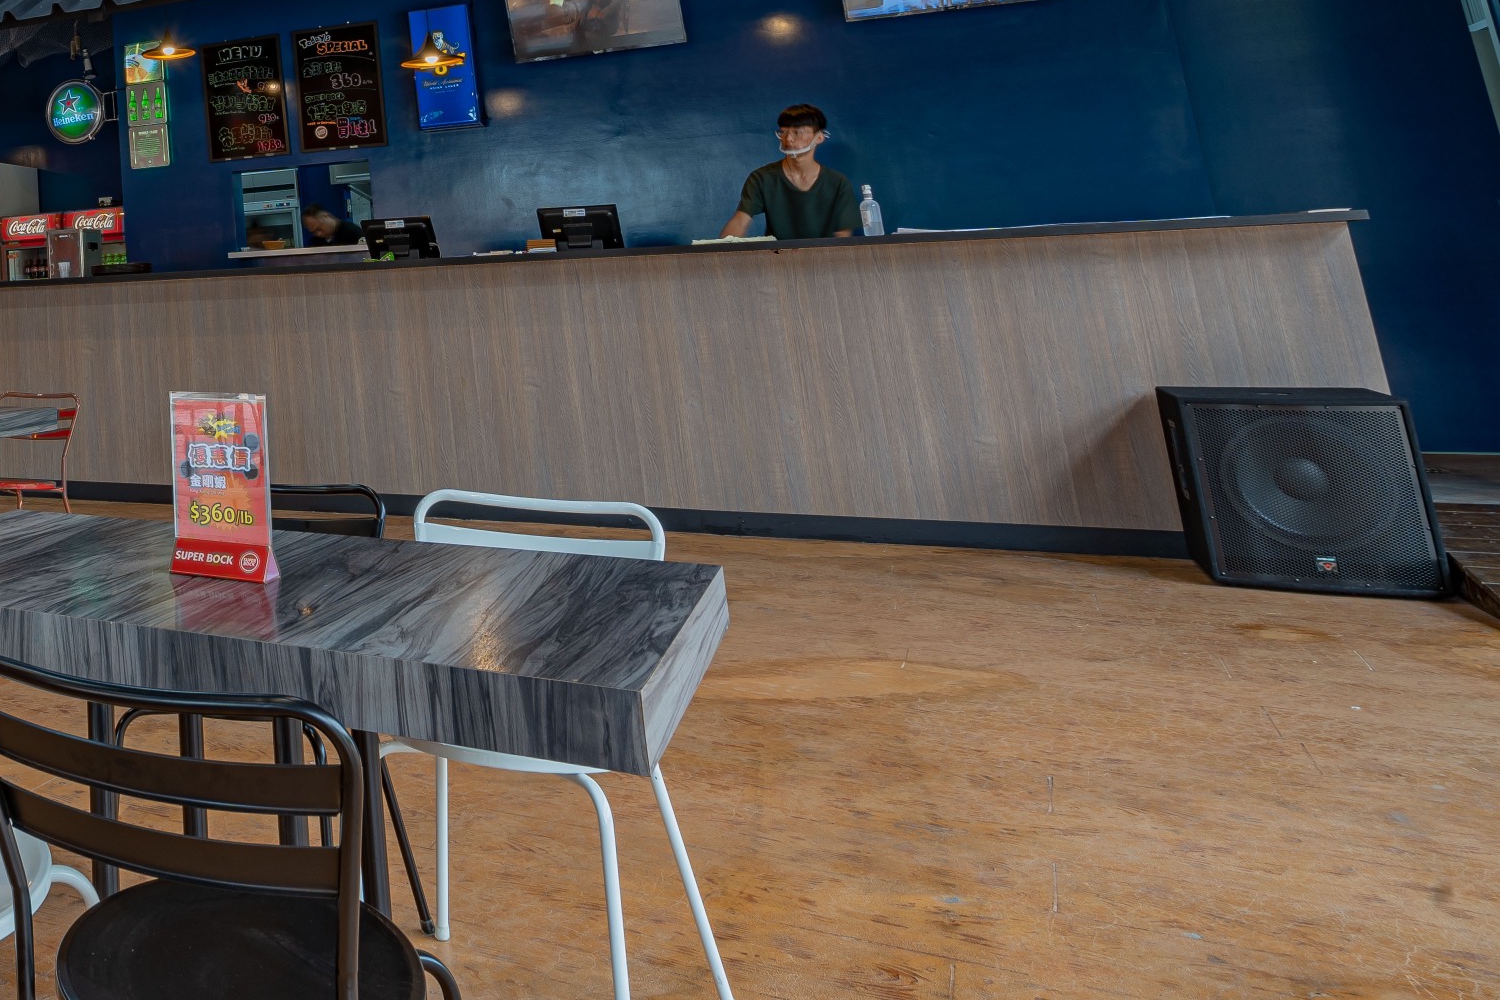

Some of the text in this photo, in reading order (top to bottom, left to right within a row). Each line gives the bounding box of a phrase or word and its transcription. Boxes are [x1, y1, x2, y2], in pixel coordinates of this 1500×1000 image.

[217, 45, 263, 62] MENU
[316, 39, 369, 55] SPECIAL
[329, 73, 362, 90] 360
[52, 111, 95, 128] Heineken
[8, 217, 48, 236] Coca-Cola
[74, 211, 116, 230] Coca-Cola
[188, 443, 252, 472] 優惠價
[189, 473, 227, 490] 金剛蝦
[189, 500, 254, 528] $360/lb
[175, 549, 234, 566] SUPER BOCK
